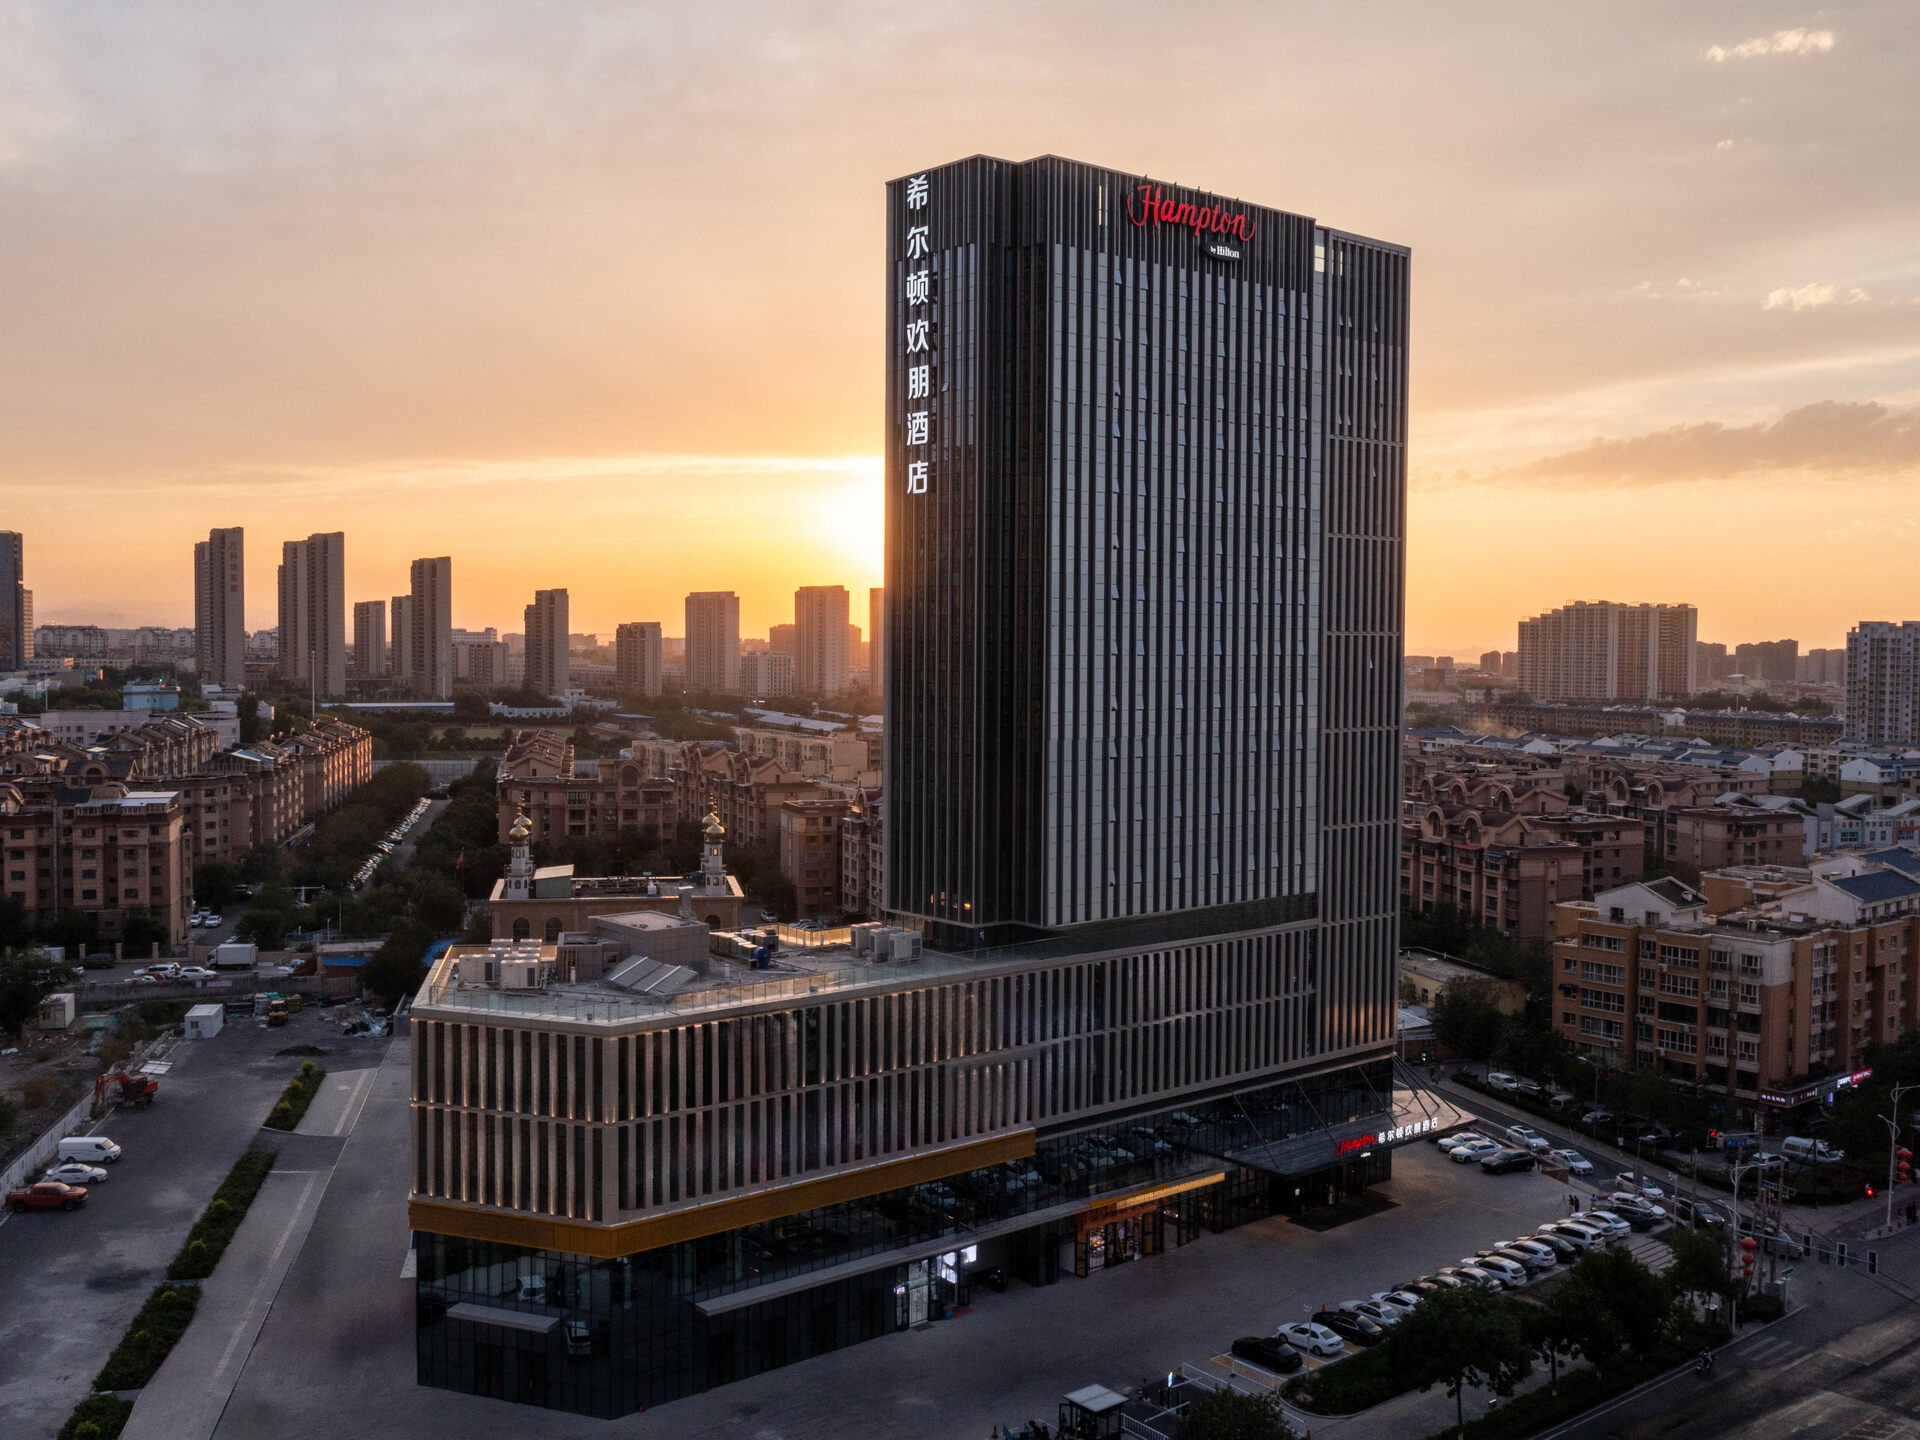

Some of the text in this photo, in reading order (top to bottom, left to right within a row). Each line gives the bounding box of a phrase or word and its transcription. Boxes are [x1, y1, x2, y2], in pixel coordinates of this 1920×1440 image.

[1127, 185, 1256, 241] Hampton
[1210, 245, 1240, 259] by Hilton
[906, 174, 929, 495] 希尔顿欢朋酒店
